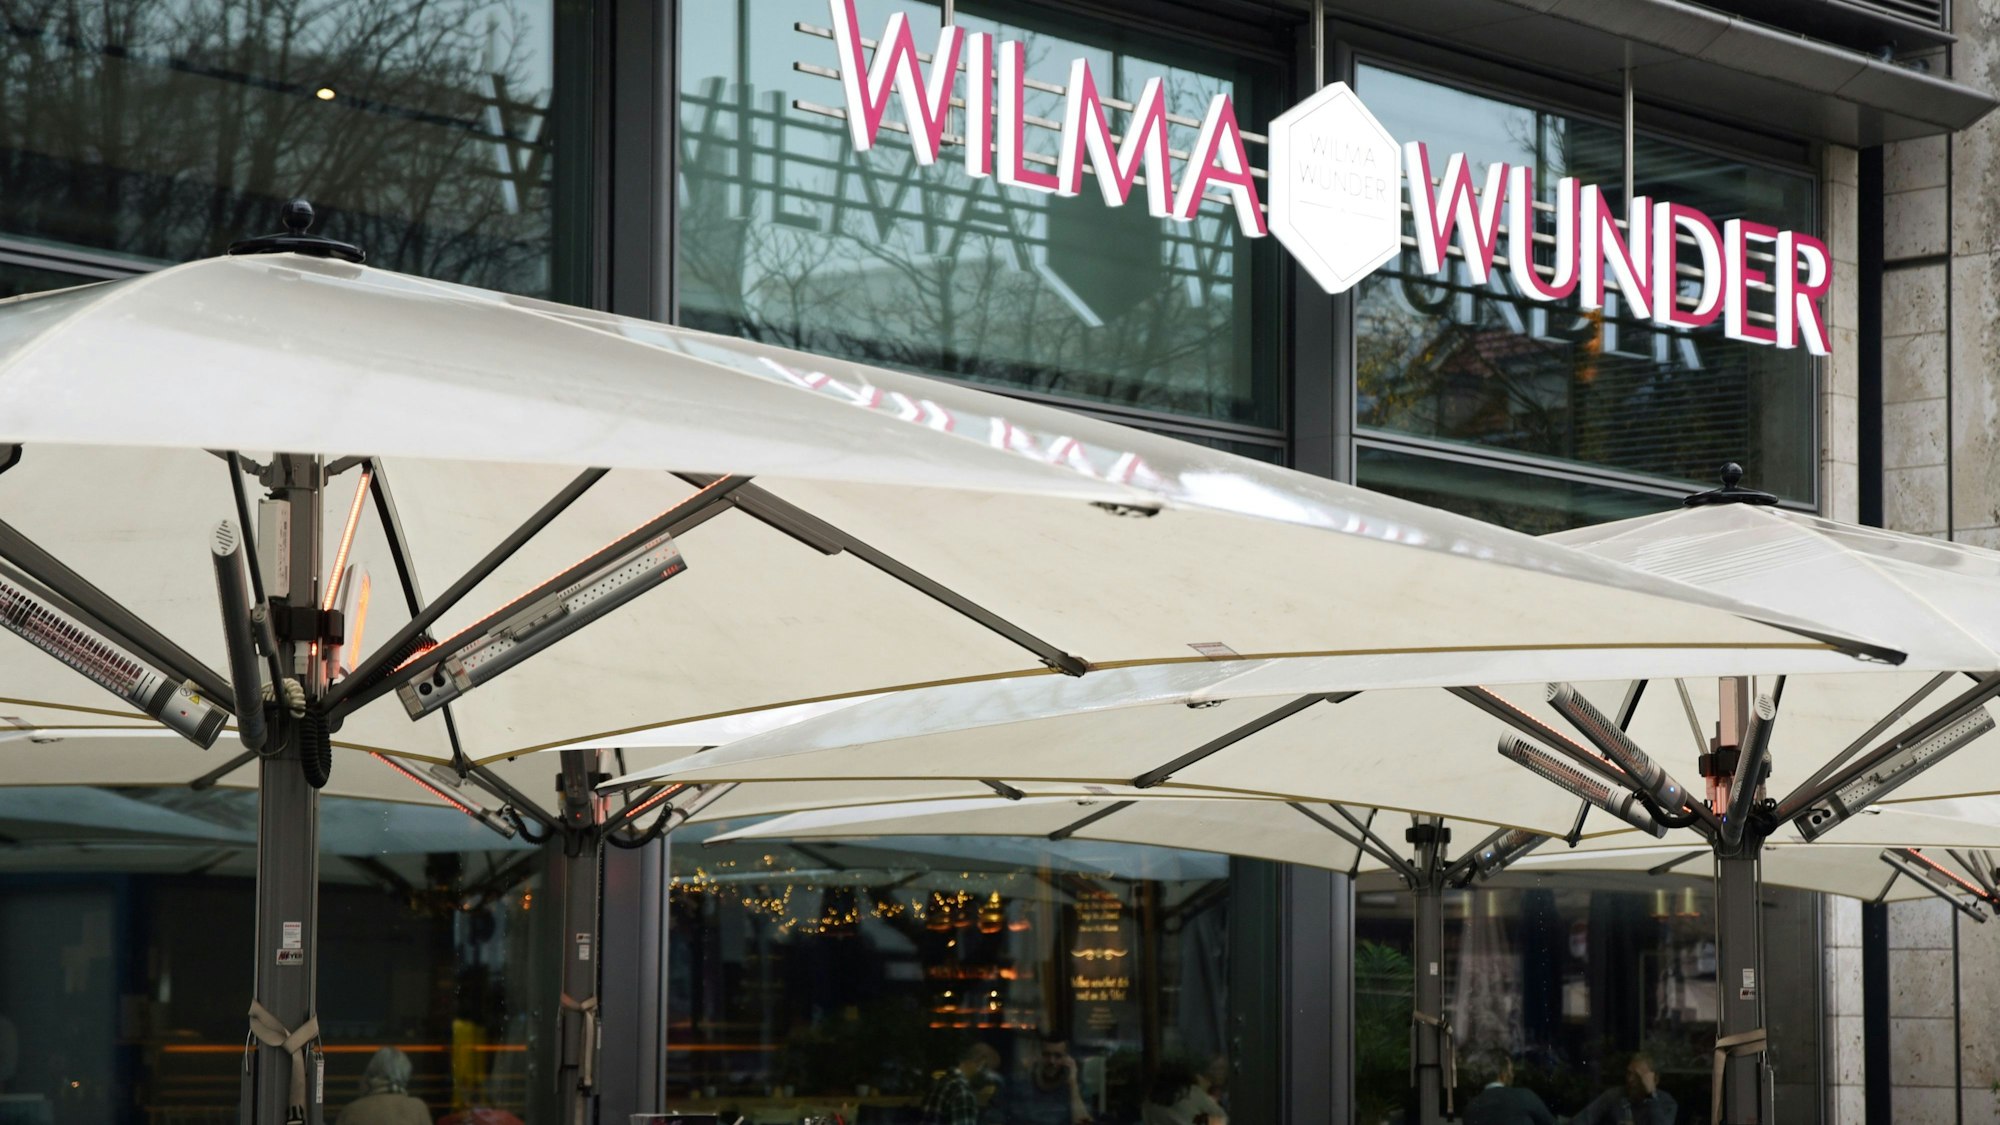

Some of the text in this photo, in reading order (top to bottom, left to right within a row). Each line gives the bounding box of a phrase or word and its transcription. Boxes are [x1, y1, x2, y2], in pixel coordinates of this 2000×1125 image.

[1310, 134, 1376, 168] WILMA
[830, 0, 1268, 238] WILMA
[1404, 141, 1833, 356] WUNDER
[1298, 161, 1386, 202] WUNDER
